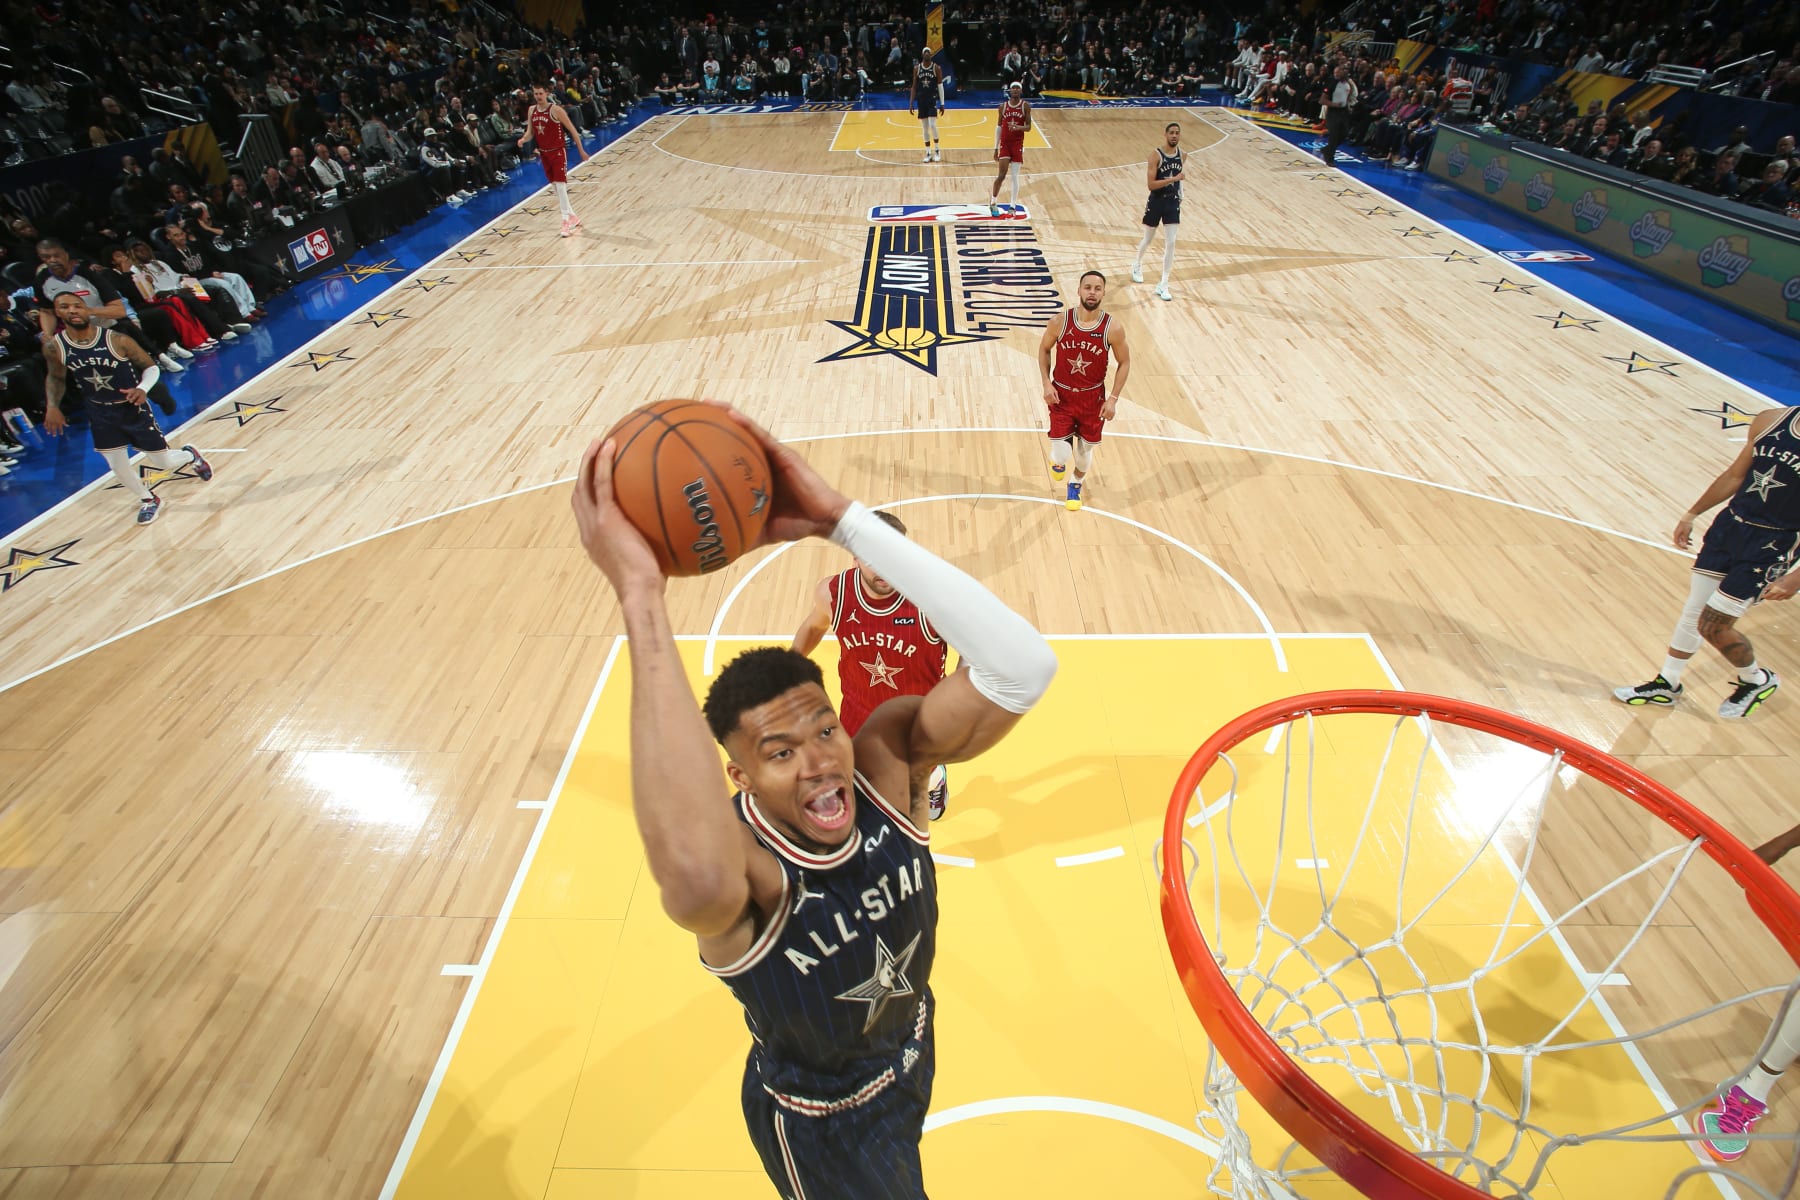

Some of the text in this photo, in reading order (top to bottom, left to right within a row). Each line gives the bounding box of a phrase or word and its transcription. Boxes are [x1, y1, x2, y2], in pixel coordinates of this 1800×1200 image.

[792, 103, 855, 112] 2024
[1572, 191, 1610, 229] Starry
[1629, 212, 1674, 254] Starry
[880, 254, 930, 294] INDY
[1698, 237, 1753, 285] Starry
[963, 289, 1064, 333] 2024
[1060, 340, 1103, 356] ALL-STAR
[1752, 446, 1800, 475] ALL-STA
[842, 631, 917, 657] ALL-STAR
[784, 857, 923, 976] ALL-STAR
